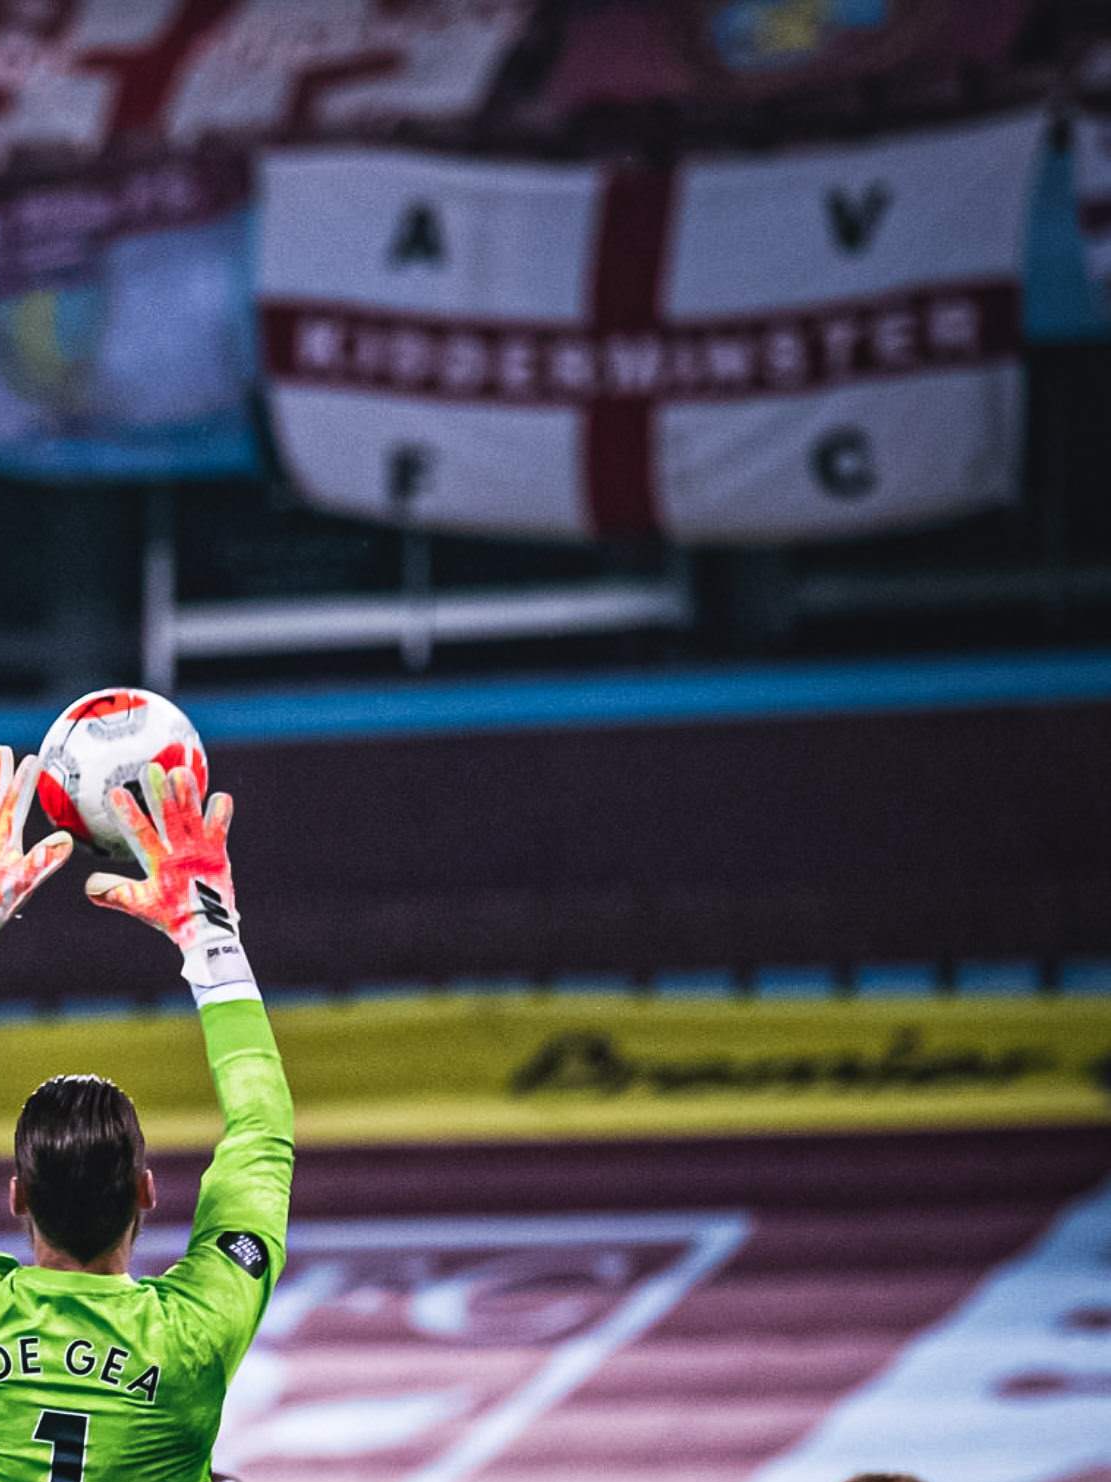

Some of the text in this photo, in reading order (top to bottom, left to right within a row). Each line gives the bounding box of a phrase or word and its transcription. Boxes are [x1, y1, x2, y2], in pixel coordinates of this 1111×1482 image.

[388, 181, 891, 269] A V
[65, 1339, 162, 1402] GEA
